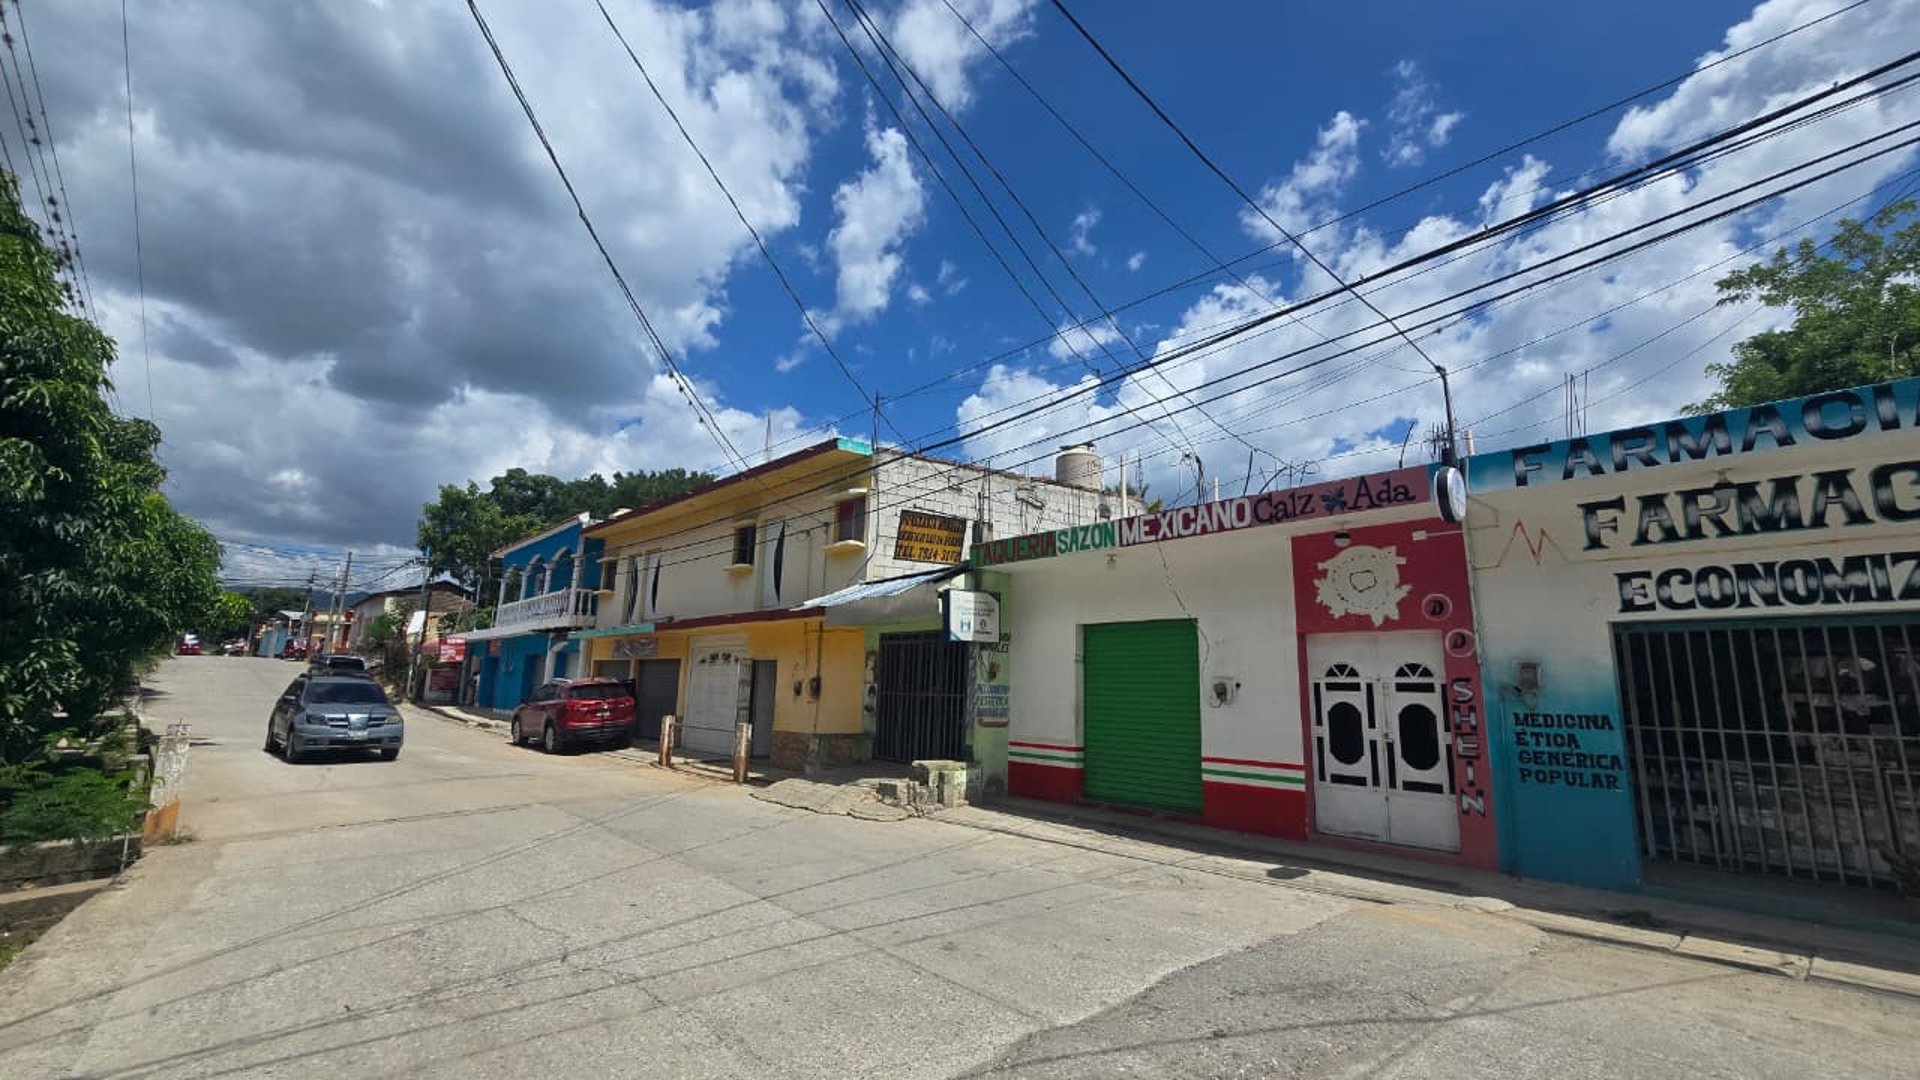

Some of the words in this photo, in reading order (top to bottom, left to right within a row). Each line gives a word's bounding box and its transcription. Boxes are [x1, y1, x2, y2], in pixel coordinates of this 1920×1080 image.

[1511, 382, 1920, 487] FARMACI
[1121, 498, 1251, 546] MEXICANO
[1253, 491, 1316, 524] Calz
[1348, 475, 1417, 511] Ada
[1451, 677, 1486, 816] SHEIN
[1512, 711, 1615, 731] MEDICINA
[1520, 767, 1621, 790] POPULAR
